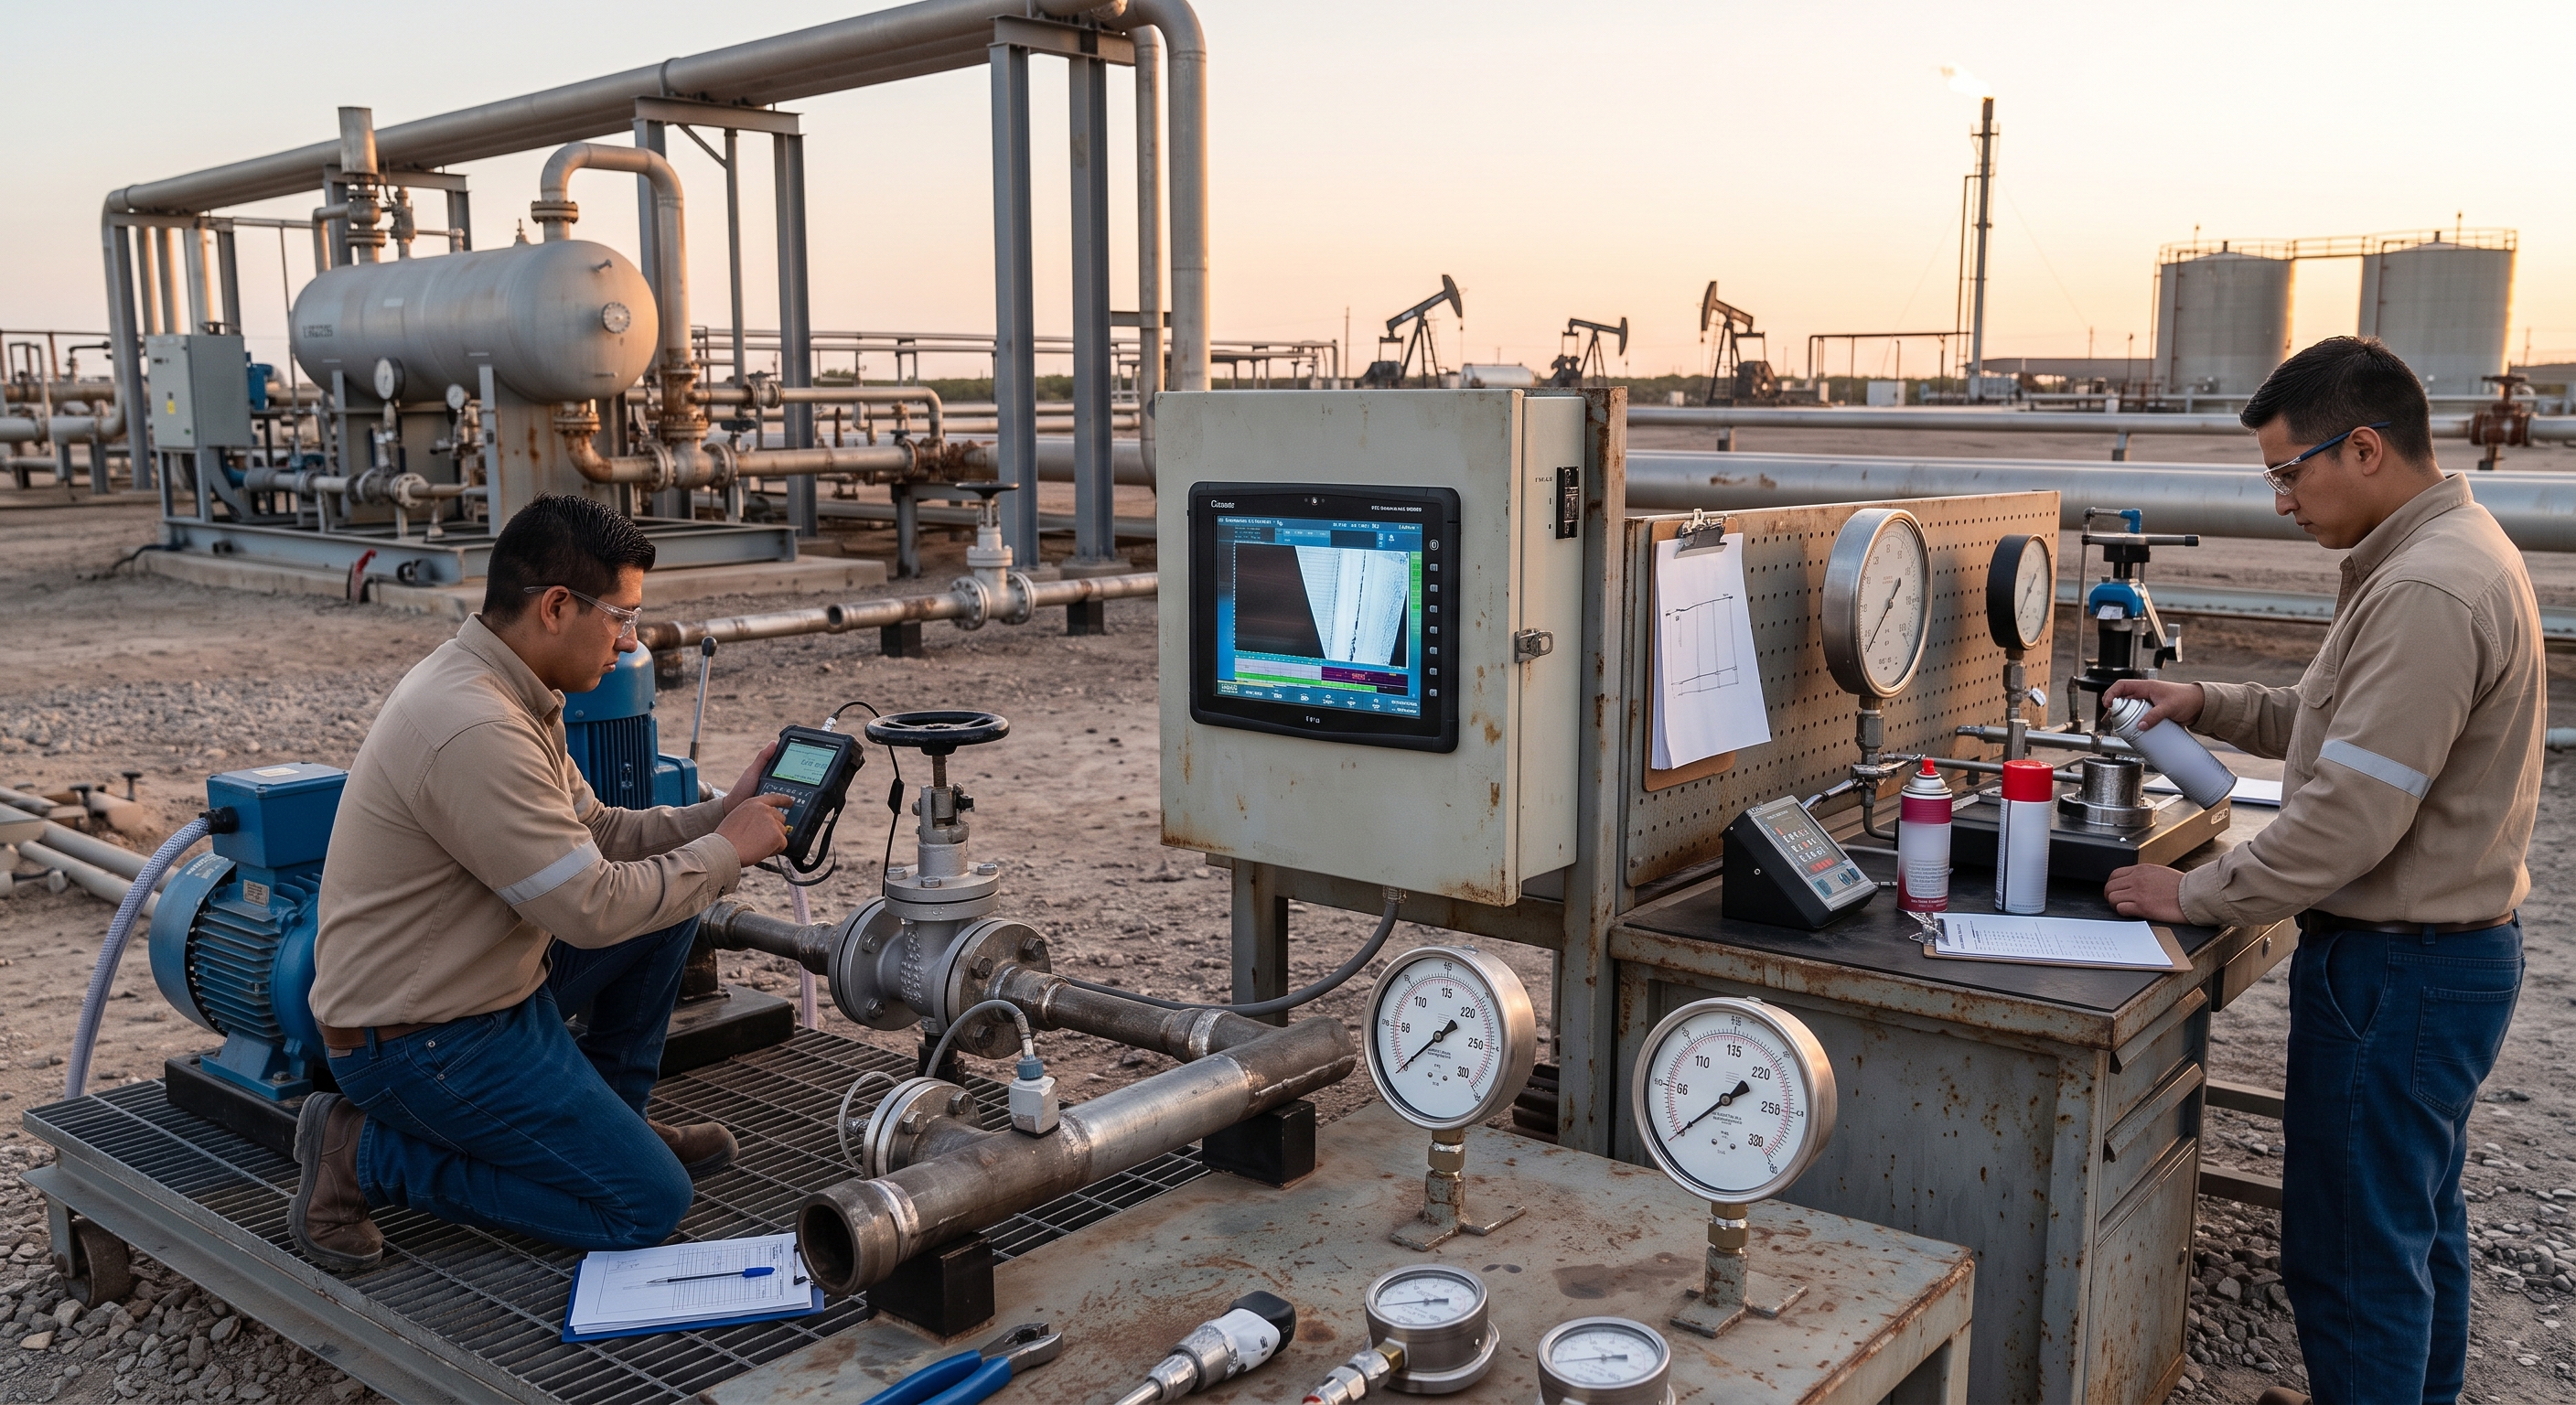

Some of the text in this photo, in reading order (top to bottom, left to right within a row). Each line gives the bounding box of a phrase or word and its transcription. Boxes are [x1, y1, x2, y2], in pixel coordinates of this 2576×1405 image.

[1460, 1006, 1476, 1019] 220
[1467, 1037, 1484, 1050] 250
[1726, 1044, 1743, 1058] 135
[1695, 1055, 1711, 1068] 110
[1751, 1066, 1771, 1080] 220
